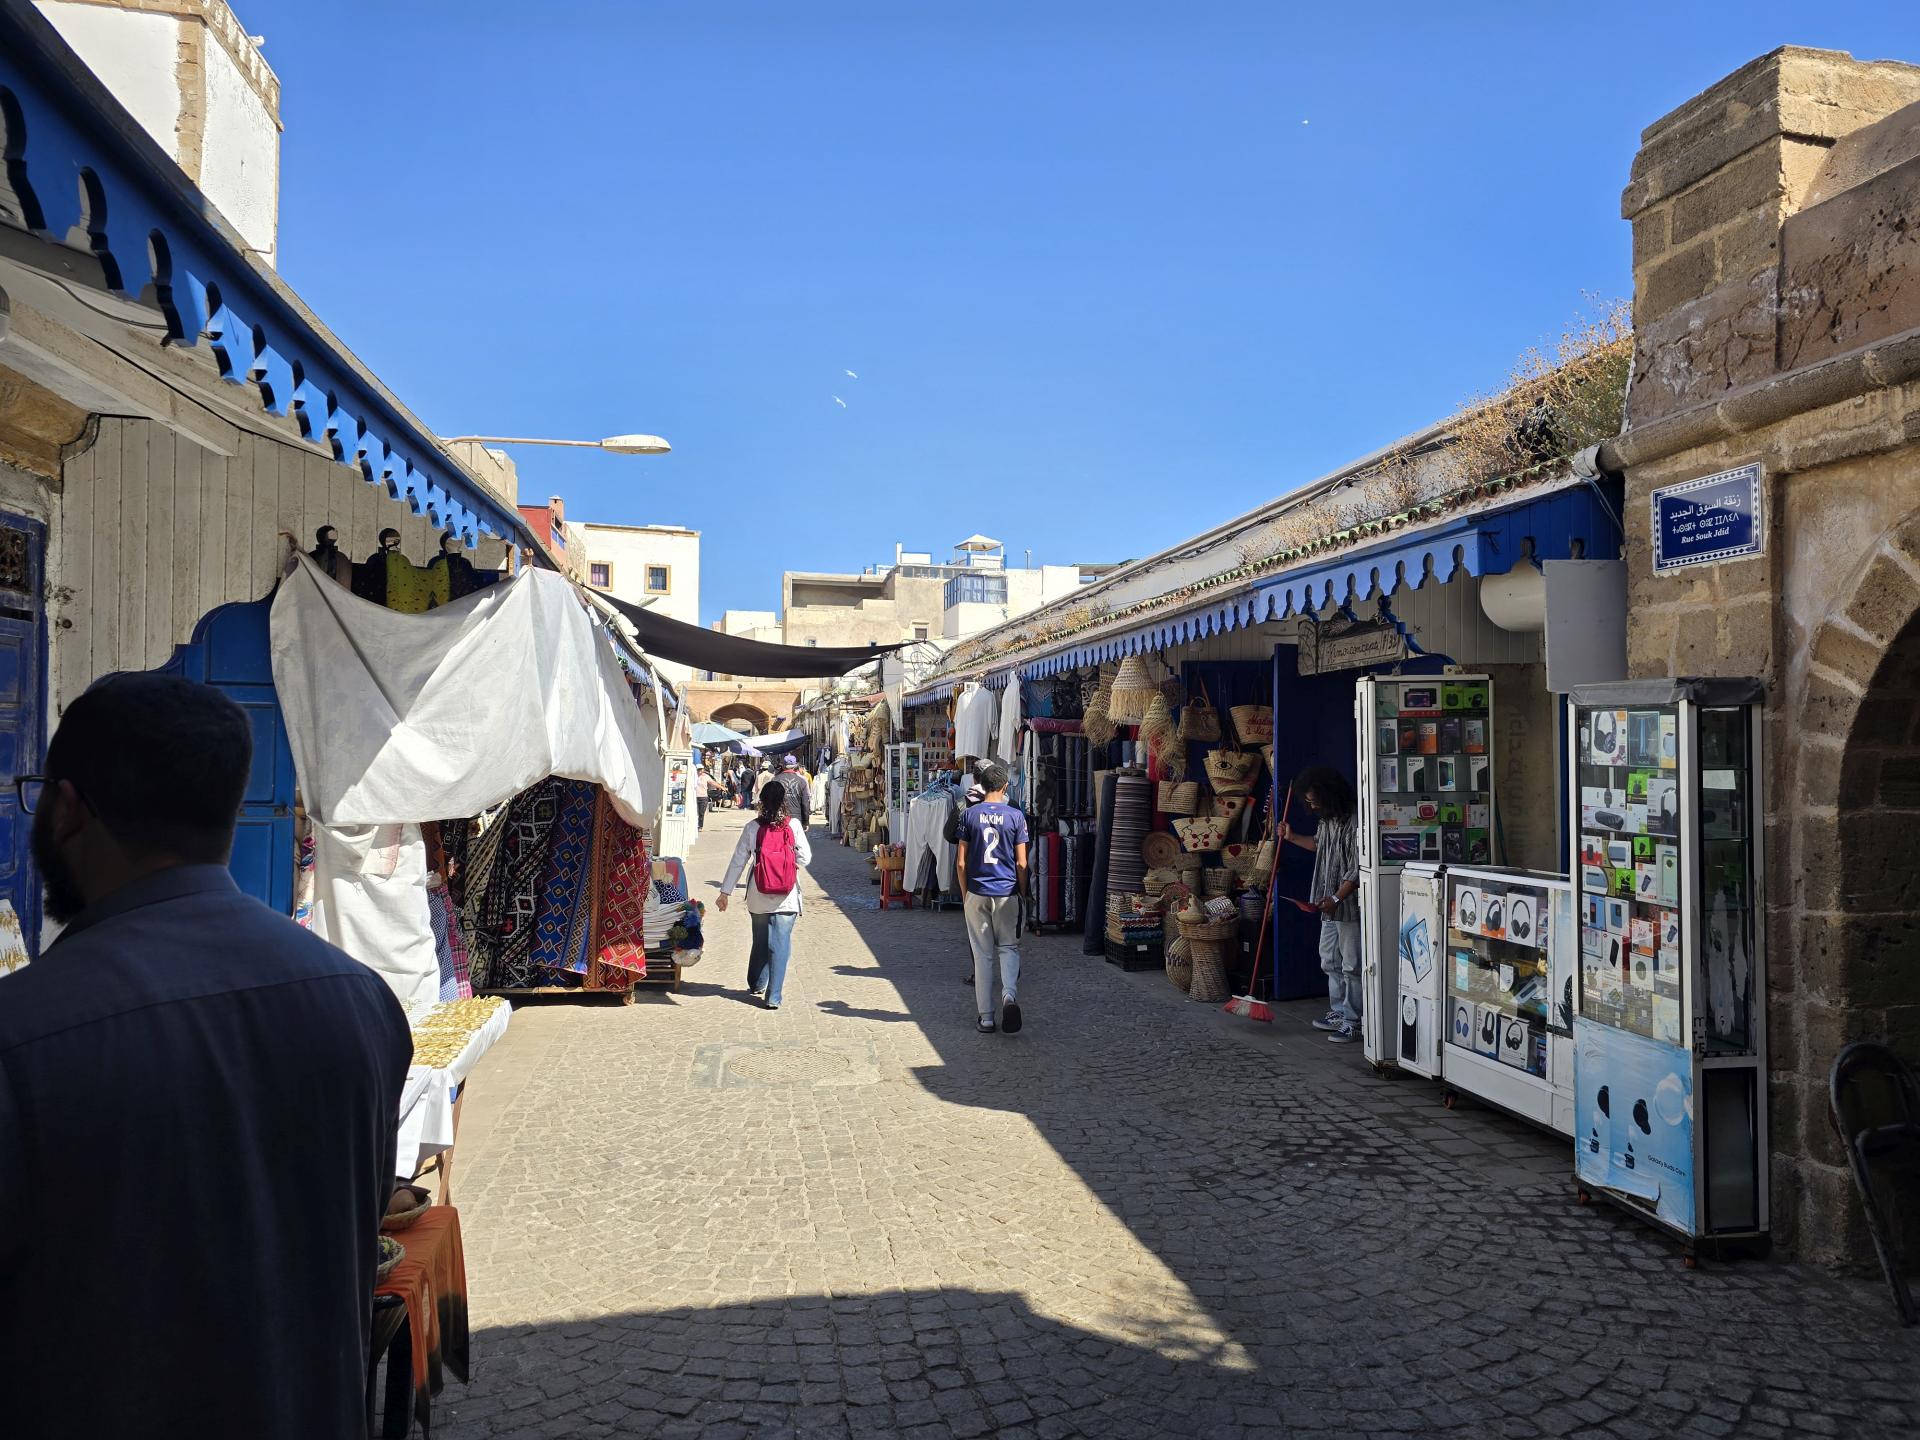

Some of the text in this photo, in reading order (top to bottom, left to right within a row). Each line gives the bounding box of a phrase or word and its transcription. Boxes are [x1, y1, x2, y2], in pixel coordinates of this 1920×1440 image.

[1669, 494, 1741, 522] زنقة السوق الجديد
[1681, 526, 1729, 544] Rue Souk Jdid
[983, 826, 1000, 865] 2
[1647, 1154, 1663, 1168] Galaxy
